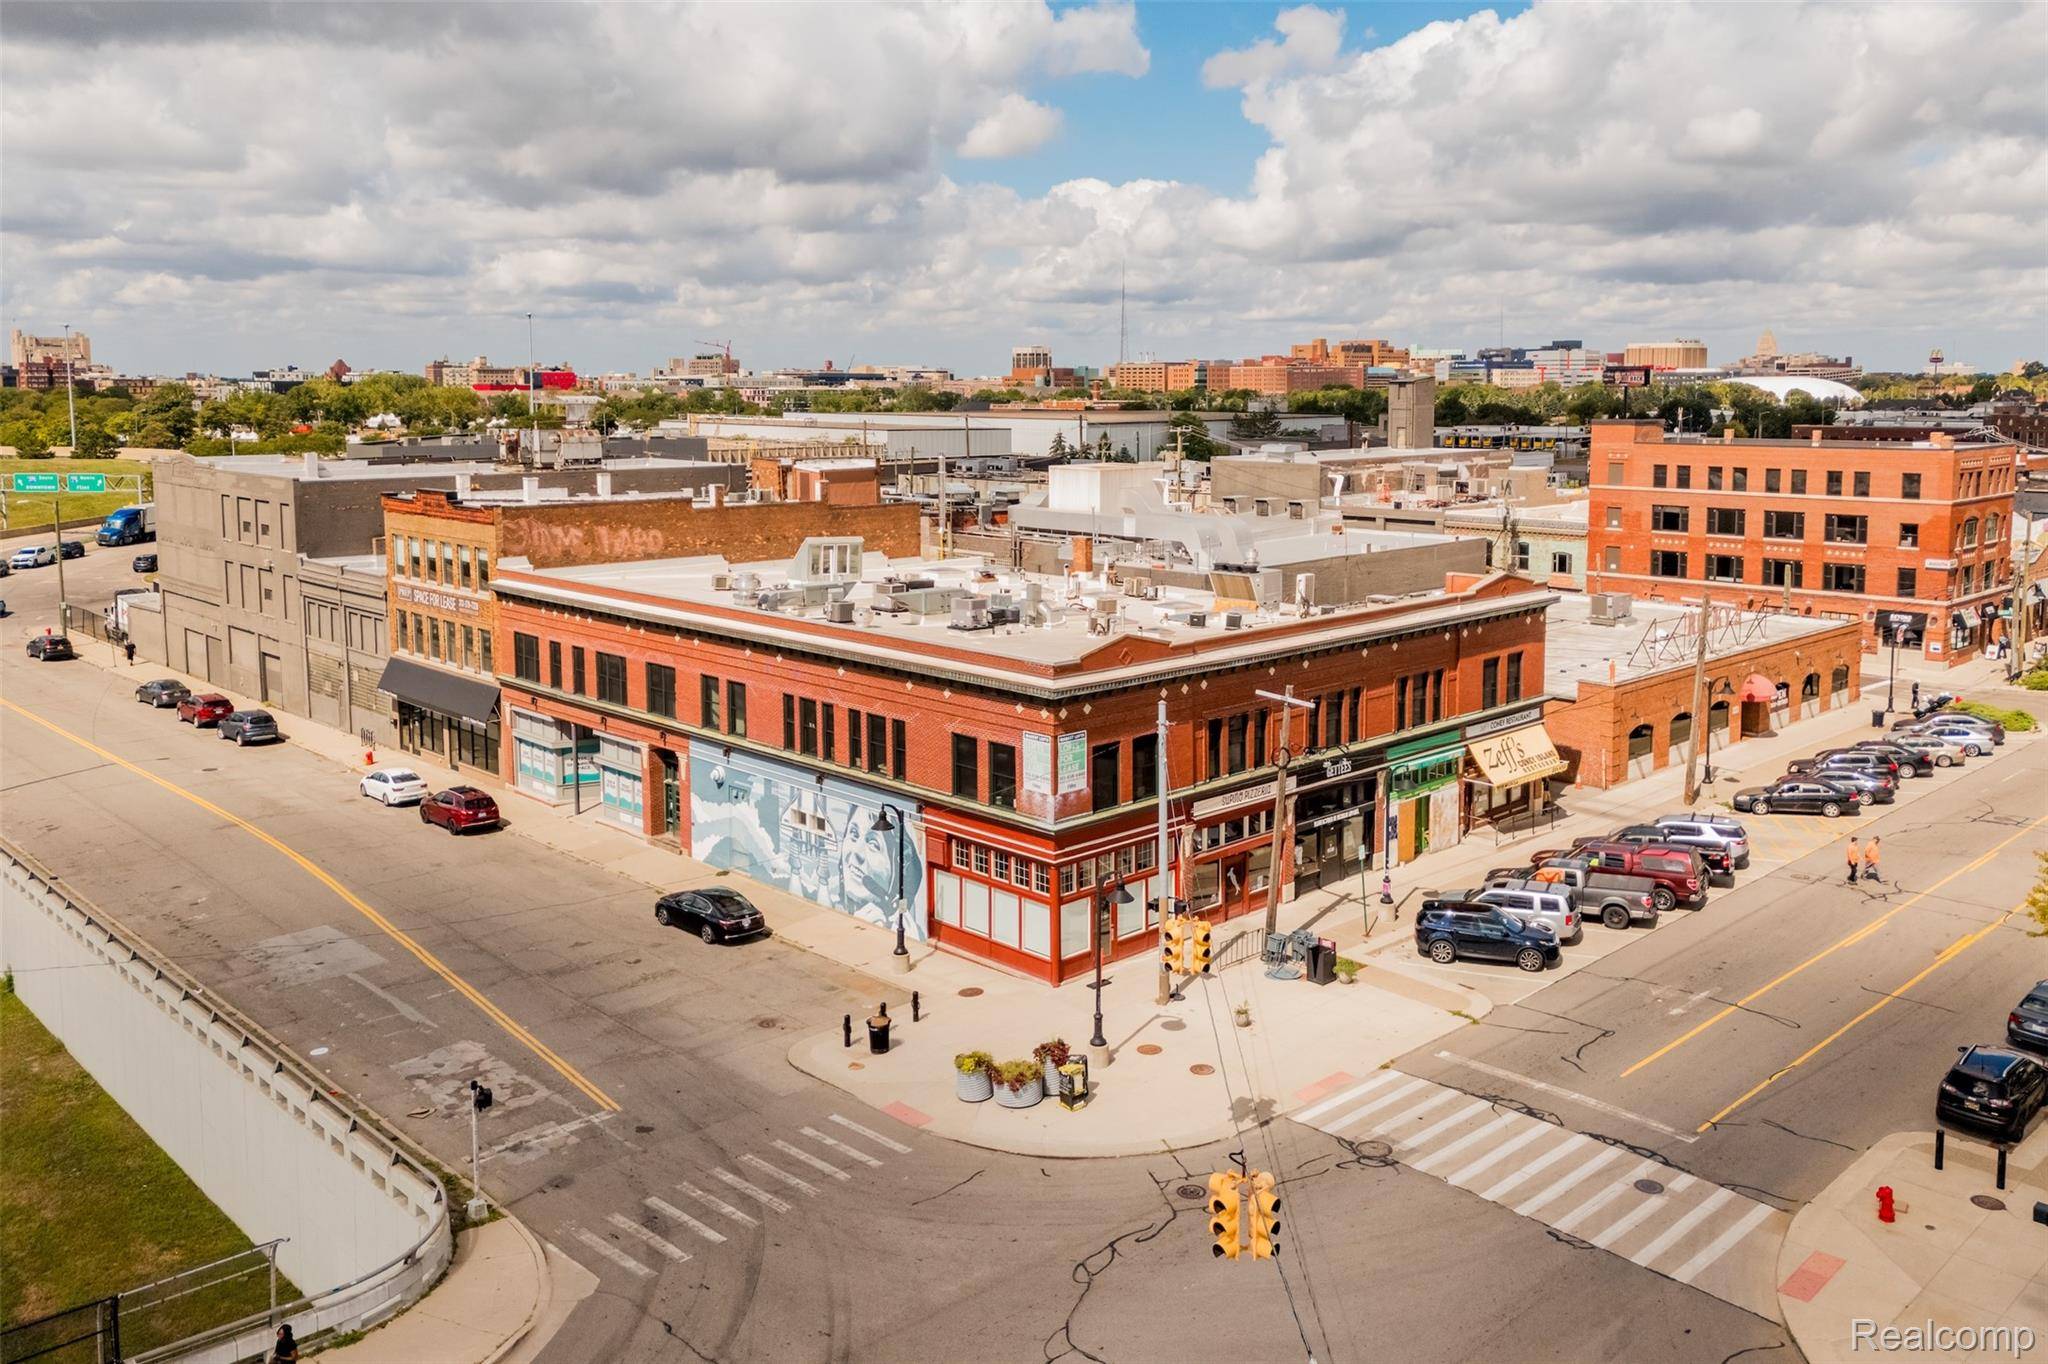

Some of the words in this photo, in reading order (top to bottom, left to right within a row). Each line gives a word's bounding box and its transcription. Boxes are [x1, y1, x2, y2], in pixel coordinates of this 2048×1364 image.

[413, 589, 429, 605] SPACE
[430, 592, 440, 606] FOR
[440, 595, 456, 610] LEASE
[1490, 718, 1506, 730] CONEY
[1506, 712, 1532, 726] RESTAURANT
[1484, 736, 1526, 773] Zeff's
[1518, 756, 1535, 768] CONEY
[1536, 750, 1556, 762] ISLAND
[1221, 792, 1243, 806] SUPINO
[1244, 785, 1271, 800] PIZZERIA
